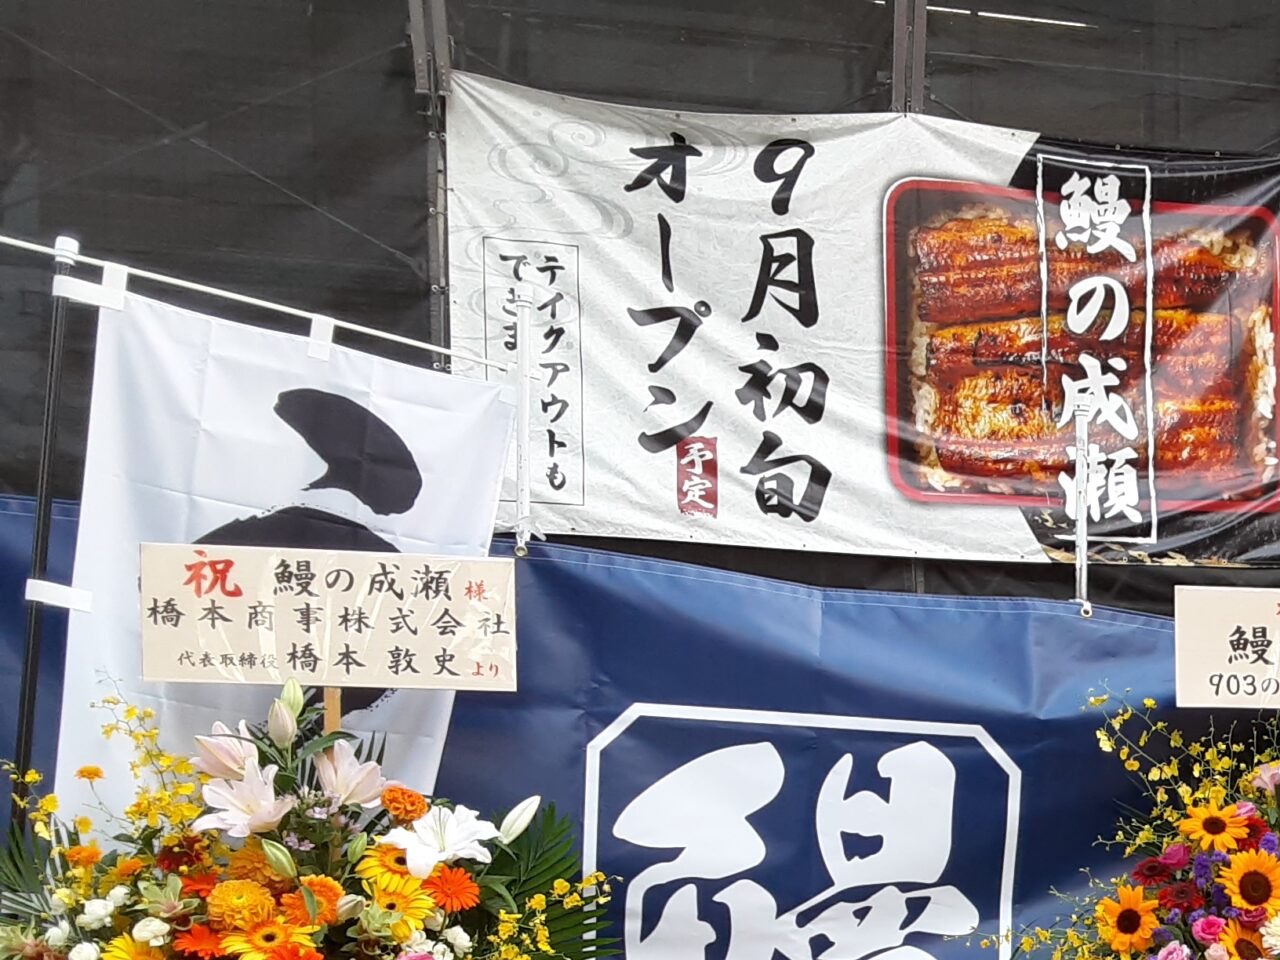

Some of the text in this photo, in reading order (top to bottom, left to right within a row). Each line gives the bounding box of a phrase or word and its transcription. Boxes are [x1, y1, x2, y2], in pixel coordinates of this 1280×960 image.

[624, 131, 713, 454] オープン
[735, 138, 833, 524] 9月初旬
[1055, 171, 1142, 523] 鰻の成瀬
[536, 254, 571, 491] テイクアウトも
[680, 442, 715, 509] 予定
[146, 597, 511, 638] 橋本商事株式会社
[182, 550, 488, 602] 祝 鰻の成瀬 様
[470, 661, 501, 679] より
